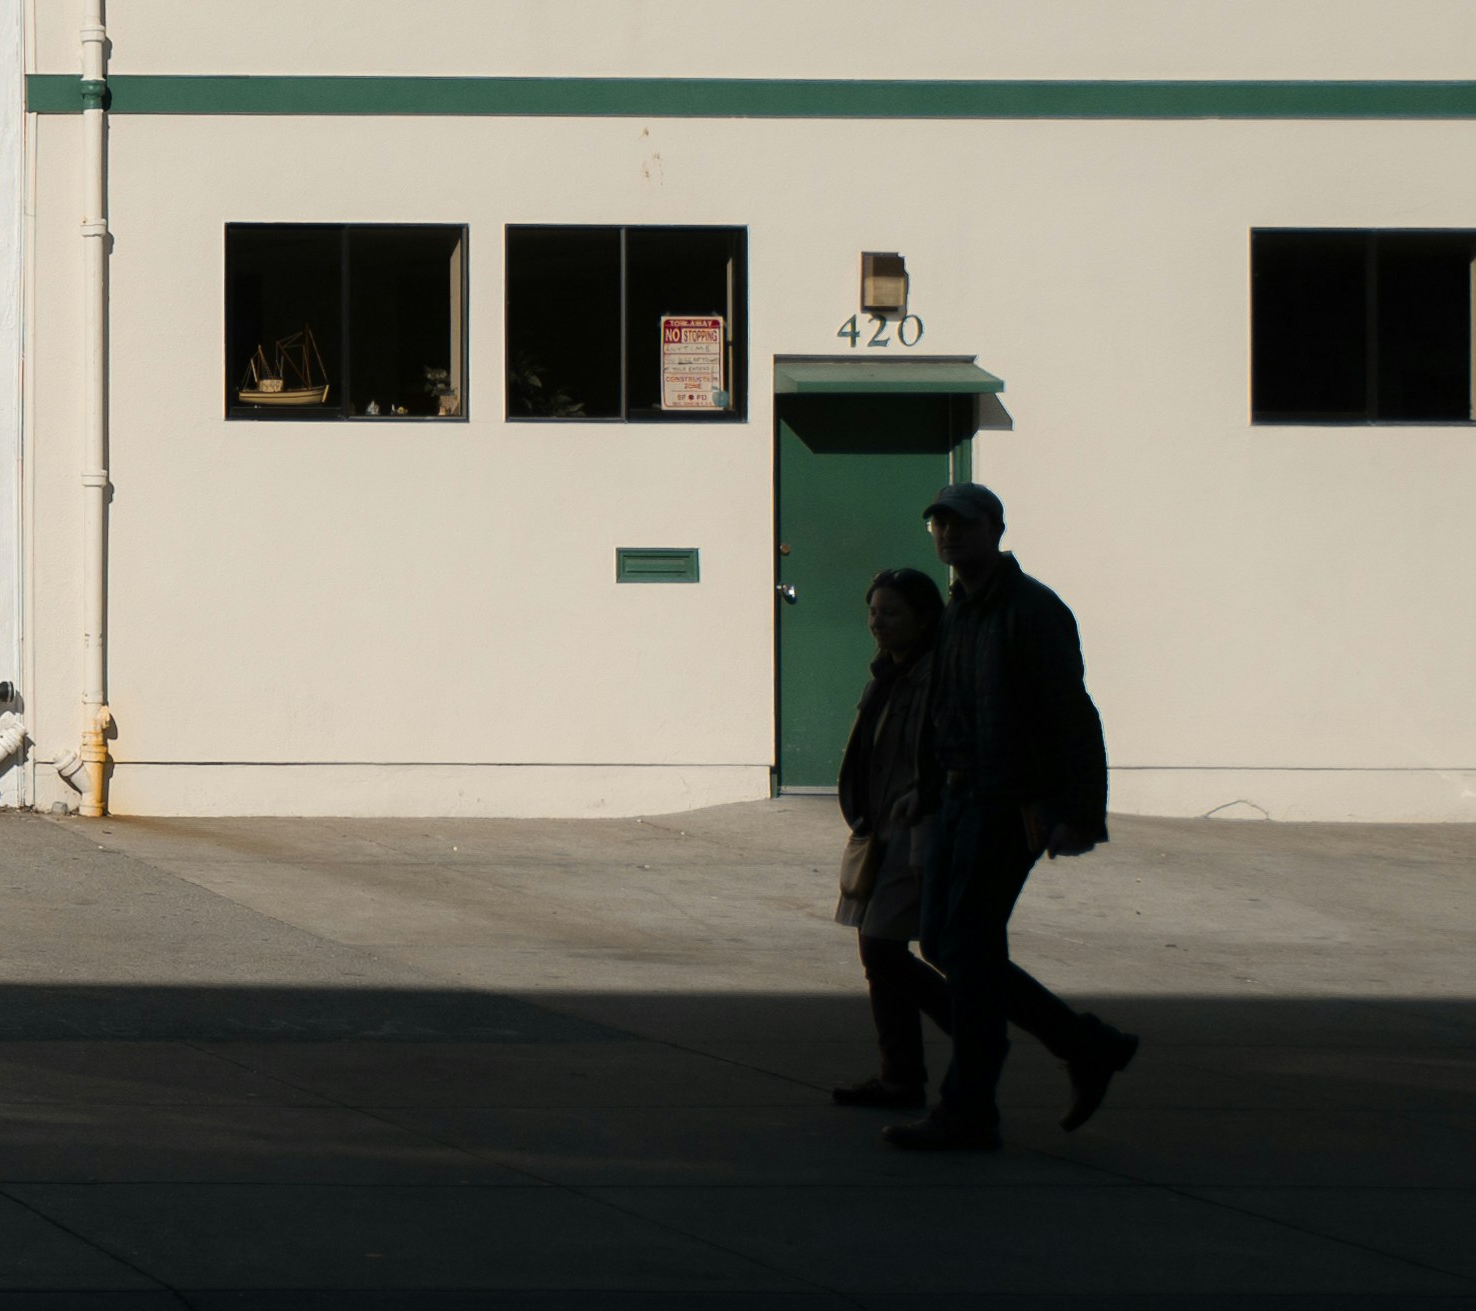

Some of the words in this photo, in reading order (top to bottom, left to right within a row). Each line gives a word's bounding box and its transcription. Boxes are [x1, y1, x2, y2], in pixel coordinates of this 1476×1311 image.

[665, 329, 680, 342] NO
[683, 329, 718, 342] STOPPING
[837, 314, 923, 348] 420
